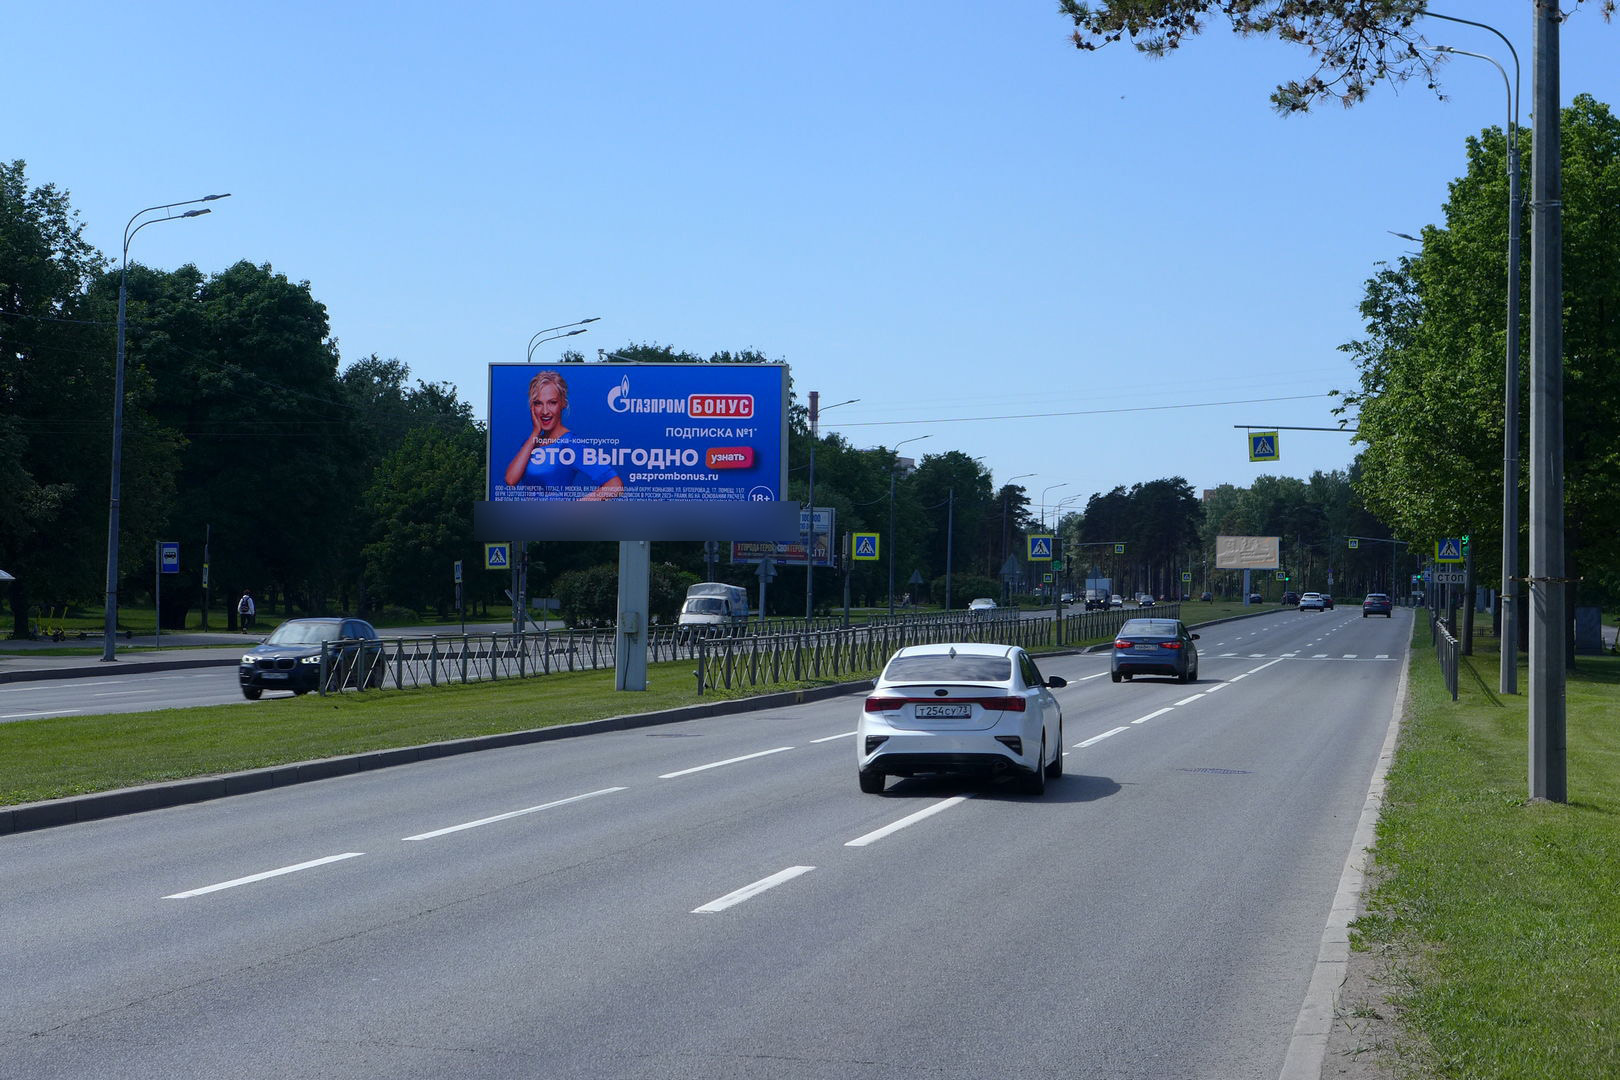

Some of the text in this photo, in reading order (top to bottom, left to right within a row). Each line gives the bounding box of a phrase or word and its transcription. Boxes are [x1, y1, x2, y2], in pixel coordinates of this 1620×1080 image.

[630, 398, 750, 414] ГАЗПРОМ БОНУС
[665, 427, 733, 439] ПОДПИСКА
[532, 436, 620, 446] Подписка-конструктор
[530, 447, 699, 470] ЭТО ВЫГОДНО
[710, 452, 746, 464] узнать
[629, 471, 719, 483] gazprombonus.ru
[1437, 573, 1464, 582] СТОП
